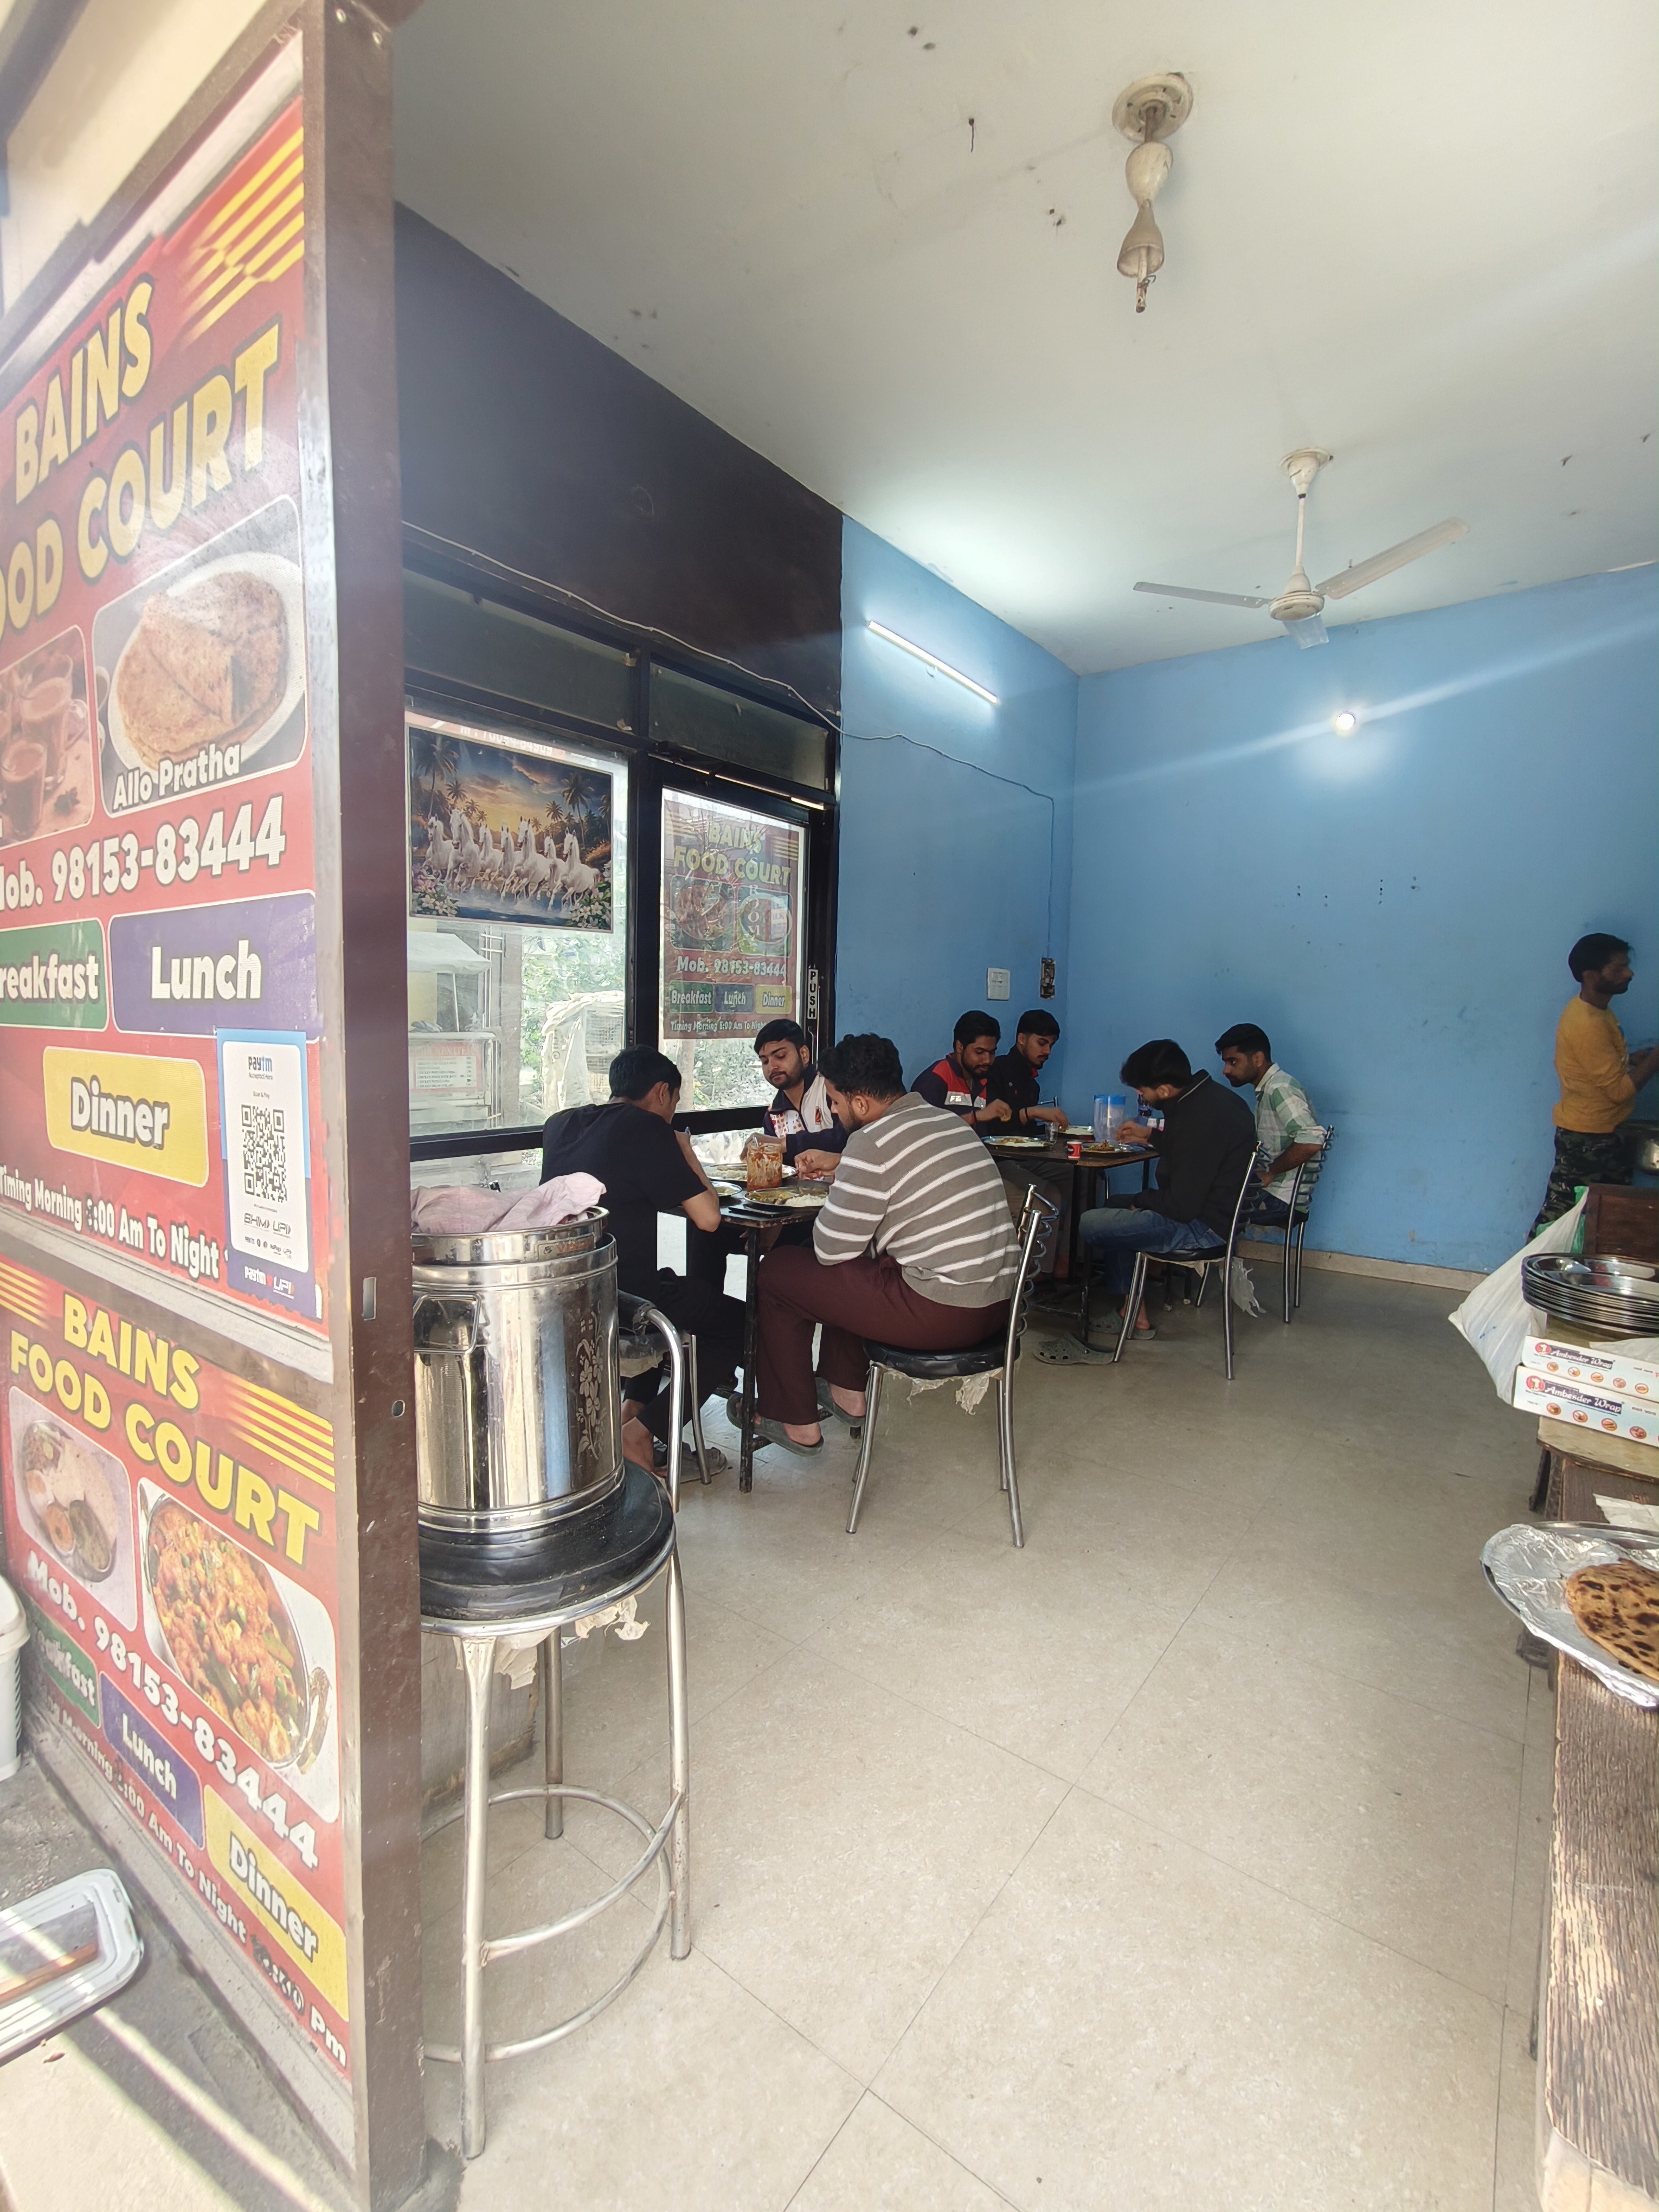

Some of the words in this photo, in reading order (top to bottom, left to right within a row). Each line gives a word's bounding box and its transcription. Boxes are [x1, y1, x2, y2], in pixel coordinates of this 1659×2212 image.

[15, 279, 154, 505] BAINS
[0, 519, 63, 641] OD
[78, 323, 280, 579] COURT
[113, 766, 152, 811] Allo
[159, 743, 240, 796] Pratha
[52, 795, 286, 903] 98153-83444
[674, 845, 728, 875] FOOD
[735, 857, 791, 886] COURT
[709, 821, 762, 854] BAINS
[0, 953, 99, 1000] reakfast
[151, 939, 262, 1000] Lunch
[671, 989, 712, 1005] Breakfast
[724, 992, 746, 1006] Lunch
[762, 992, 786, 1007] Dinner
[677, 955, 709, 973] Mob.
[714, 957, 787, 976] 98153-83444
[671, 1020, 692, 1032] Timing
[693, 1020, 718, 1032] Morning
[733, 1021, 743, 1030] Am
[744, 1021, 750, 1030] To
[72, 1078, 169, 1146] Dinner
[35, 1178, 82, 1231] Morning
[119, 1208, 144, 1249] Am
[147, 1217, 166, 1257] To
[171, 1225, 219, 1279] Night
[273, 1276, 292, 1295] UPI
[64, 1294, 200, 1409] BAINS
[1591, 1357, 1612, 1369] Wrap
[1545, 1385, 1592, 1404] Ambesder
[1594, 1398, 1622, 1413] Wrap
[10, 1330, 111, 1429] FOOD
[125, 1403, 319, 1565] COURT
[27, 1549, 86, 1631] Mob.
[94, 1616, 318, 1869] 98153-83444
[122, 1713, 177, 1800] Lunch
[229, 1831, 319, 1960] Dinner
[149, 1805, 172, 1854] Am
[176, 1841, 194, 1878] To
[199, 1869, 247, 1943] Night
[311, 2005, 346, 2068] Pm
